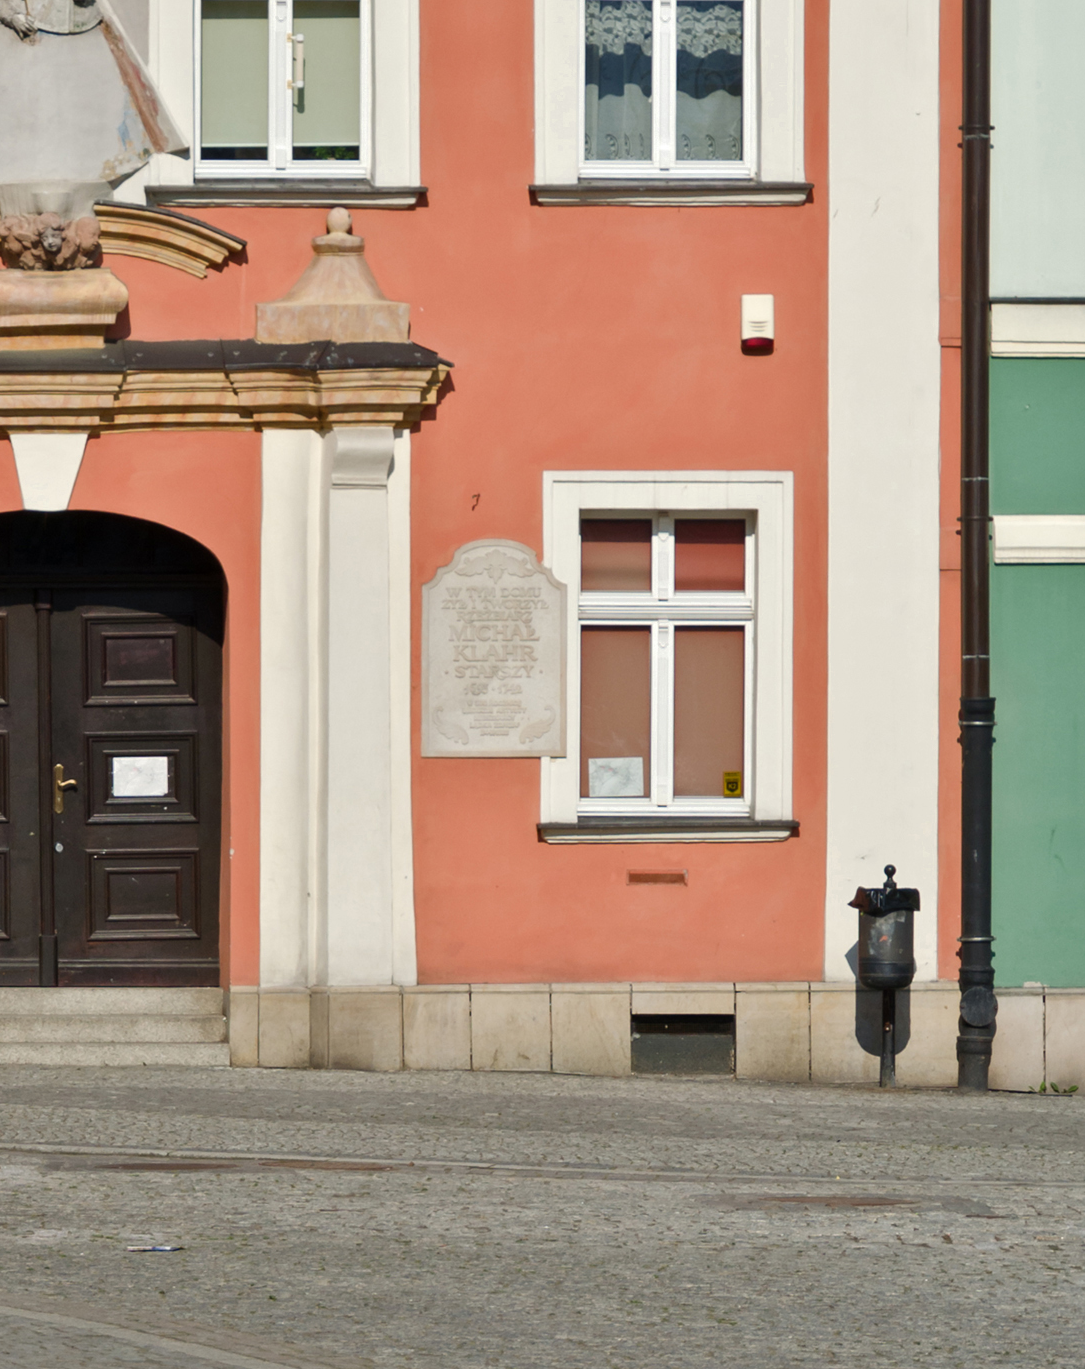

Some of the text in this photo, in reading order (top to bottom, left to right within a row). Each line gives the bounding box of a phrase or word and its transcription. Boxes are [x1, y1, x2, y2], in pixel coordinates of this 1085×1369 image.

[445, 586, 542, 598] W TYM DOMU
[448, 624, 540, 642] MICHAŁ
[453, 644, 539, 662] KLAHR
[454, 665, 535, 681] STARSZY
